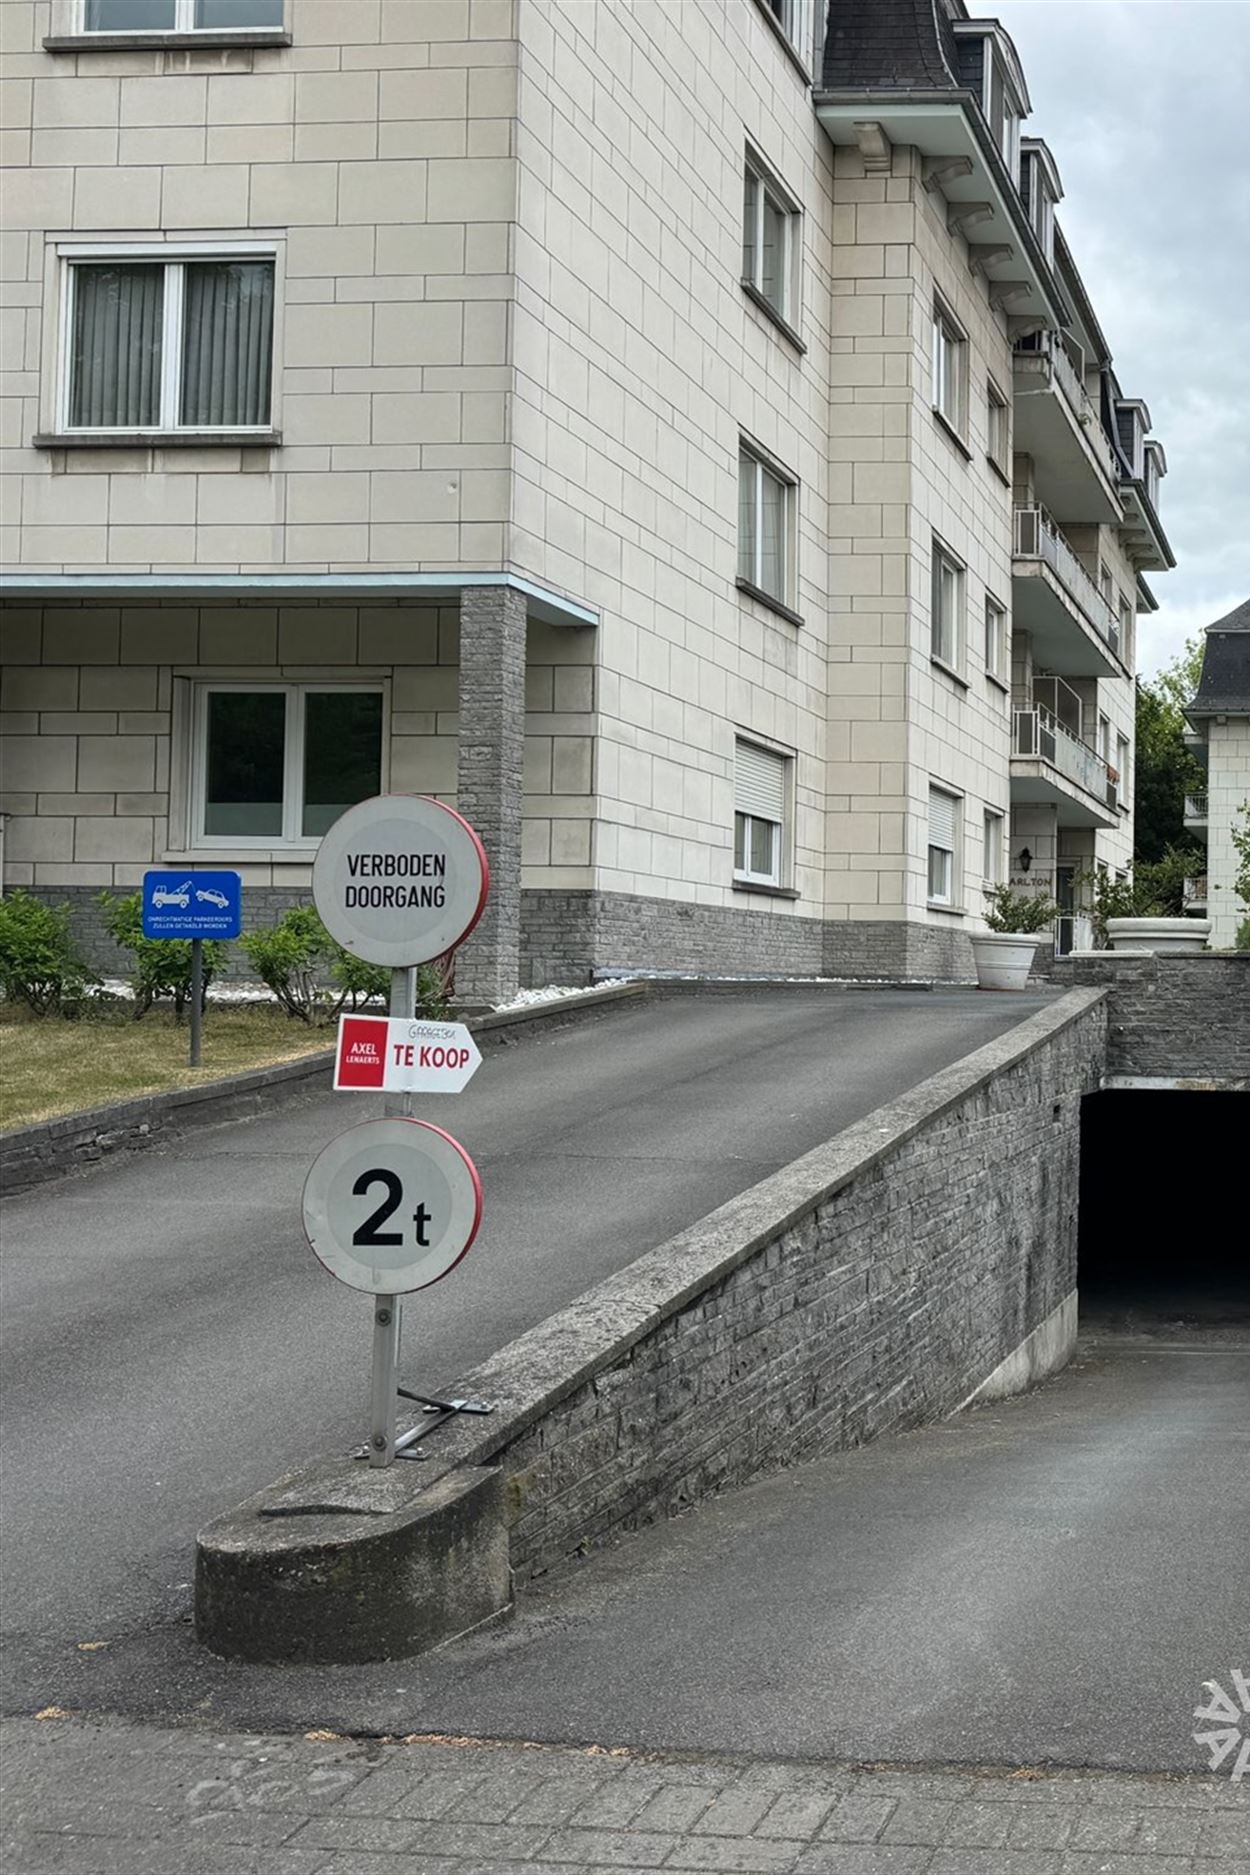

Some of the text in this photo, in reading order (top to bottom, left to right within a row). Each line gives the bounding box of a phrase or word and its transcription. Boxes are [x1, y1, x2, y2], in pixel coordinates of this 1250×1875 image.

[346, 854, 446, 877] VERBODEN
[345, 885, 446, 908] DOORGANG
[345, 1055, 380, 1065] LENAERTS
[350, 1042, 377, 1055] AXEL
[393, 1044, 470, 1069] TE KOOP
